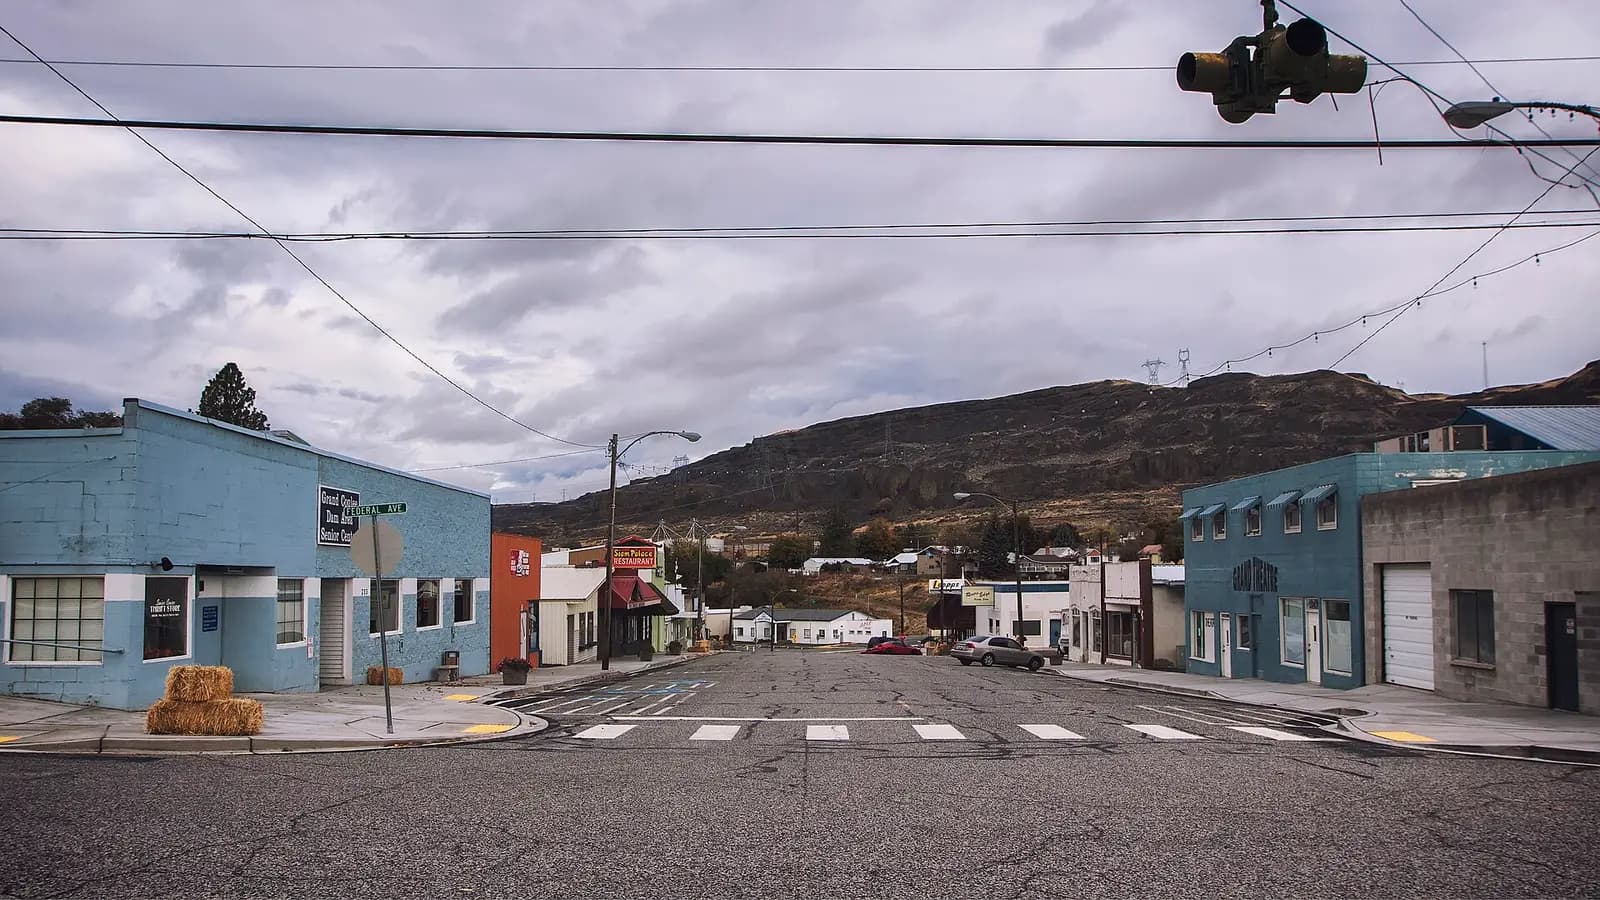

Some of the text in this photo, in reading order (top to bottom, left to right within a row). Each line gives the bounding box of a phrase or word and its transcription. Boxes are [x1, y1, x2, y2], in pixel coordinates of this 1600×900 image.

[321, 491, 358, 507] Grand Coulee
[346, 503, 402, 516] FEDERAL AVE
[326, 510, 339, 523] Dam
[320, 527, 353, 542] Senior Cent
[613, 549, 653, 557] Siam Palace
[613, 557, 654, 565] RESTAURANT
[1232, 559, 1251, 592] GRAND
